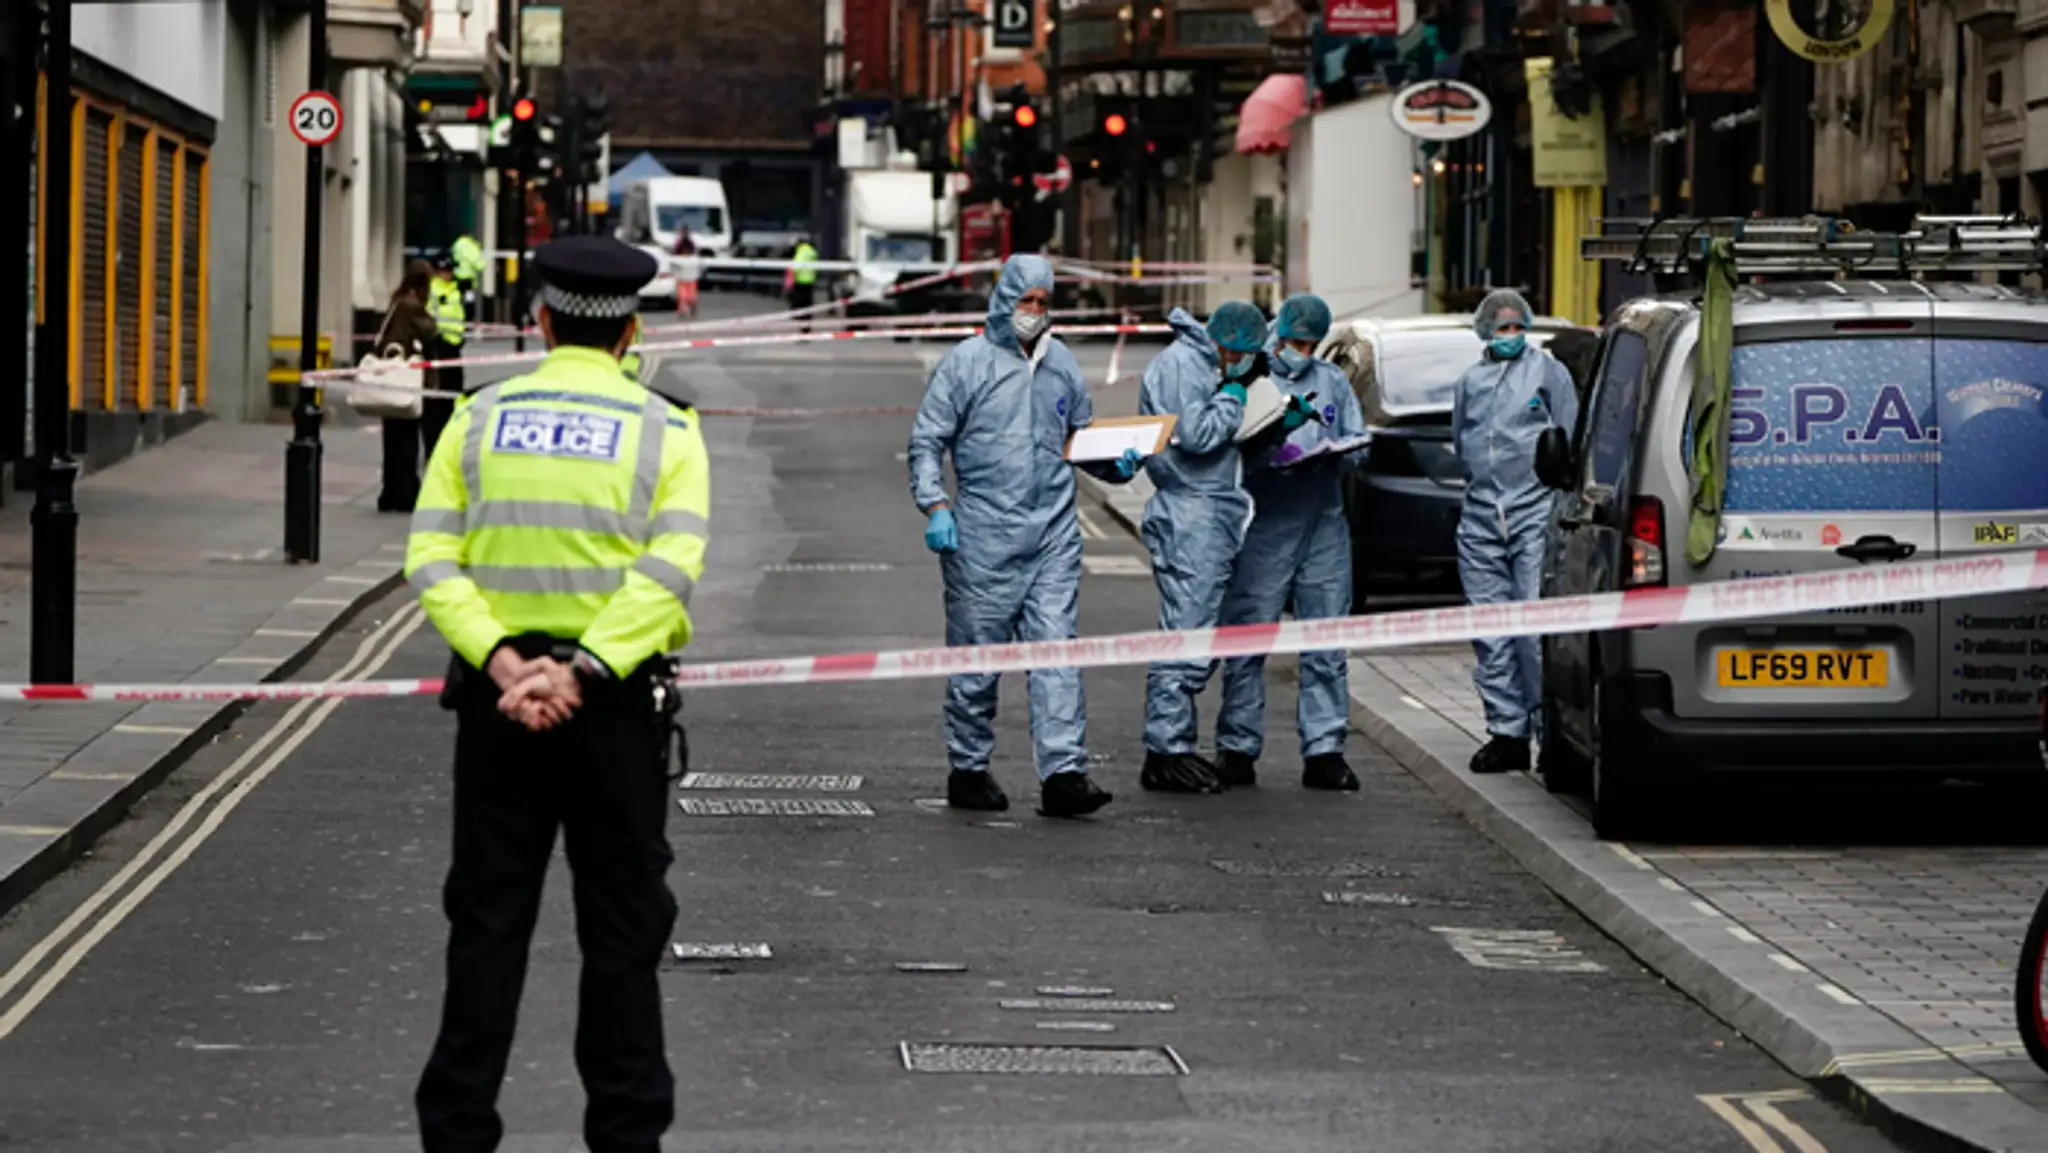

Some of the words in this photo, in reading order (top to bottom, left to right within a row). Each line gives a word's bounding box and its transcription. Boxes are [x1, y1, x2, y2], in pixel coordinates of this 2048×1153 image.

[299, 107, 335, 129] 20
[1730, 385, 1941, 443] S.P.A.
[501, 423, 611, 455] POLICE
[1975, 521, 2015, 542] IPAF
[1731, 654, 1808, 680] LF69
[1817, 654, 1873, 680] RVT
